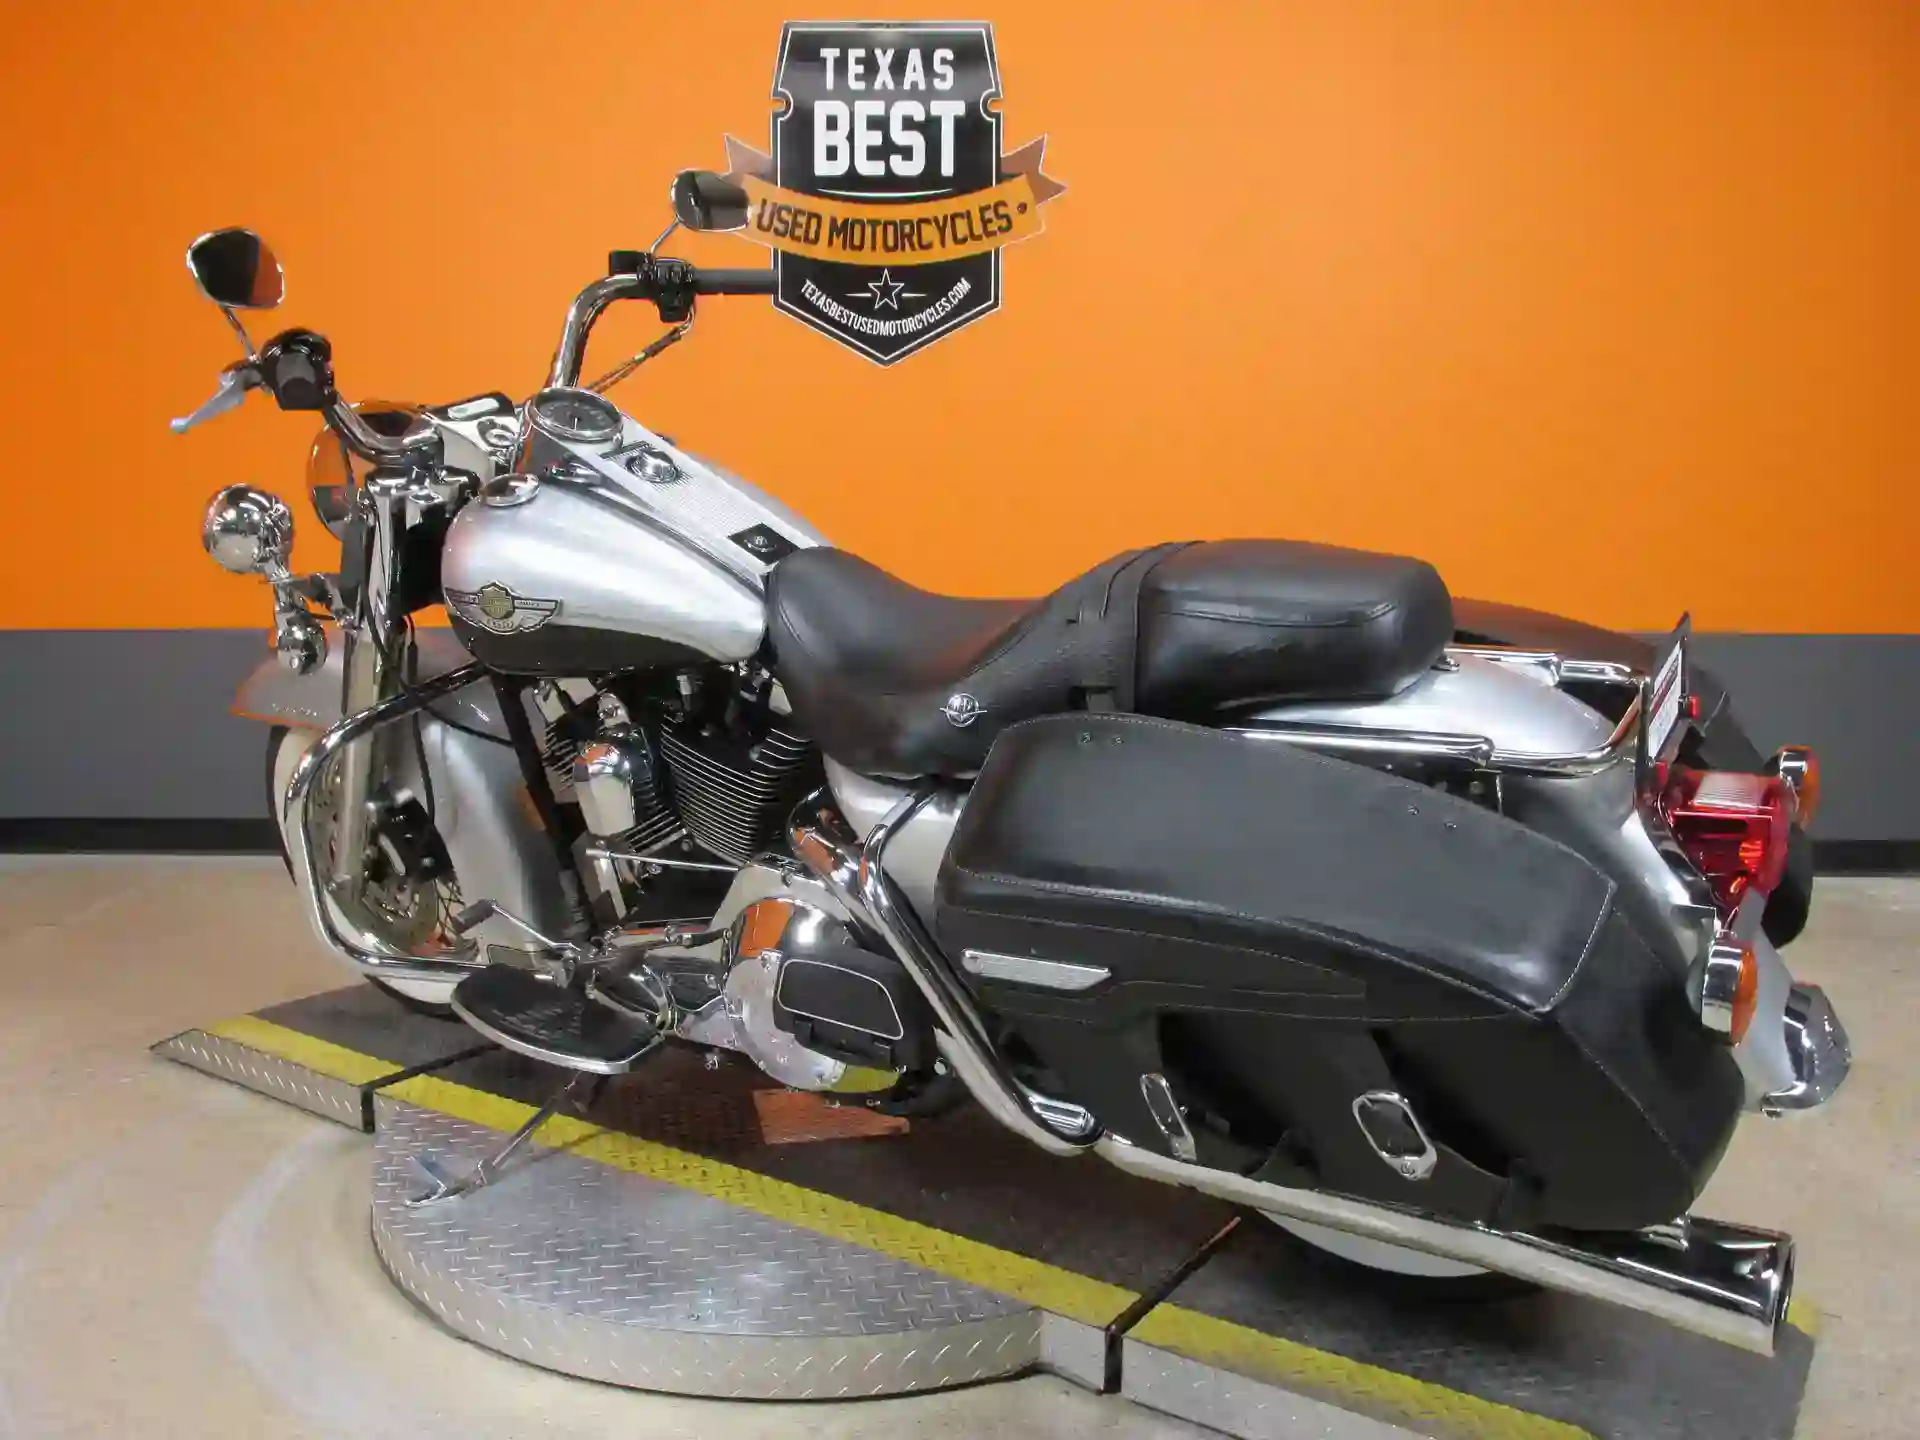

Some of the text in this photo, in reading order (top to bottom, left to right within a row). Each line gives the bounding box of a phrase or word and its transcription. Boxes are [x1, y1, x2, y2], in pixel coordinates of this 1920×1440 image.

[820, 47, 954, 91] TEXAS
[814, 100, 966, 177] BEST
[756, 198, 1012, 252] USED MOTORCYCLES
[801, 277, 972, 337] TEXASBESTUSEDMOTORCYCLES.COM
